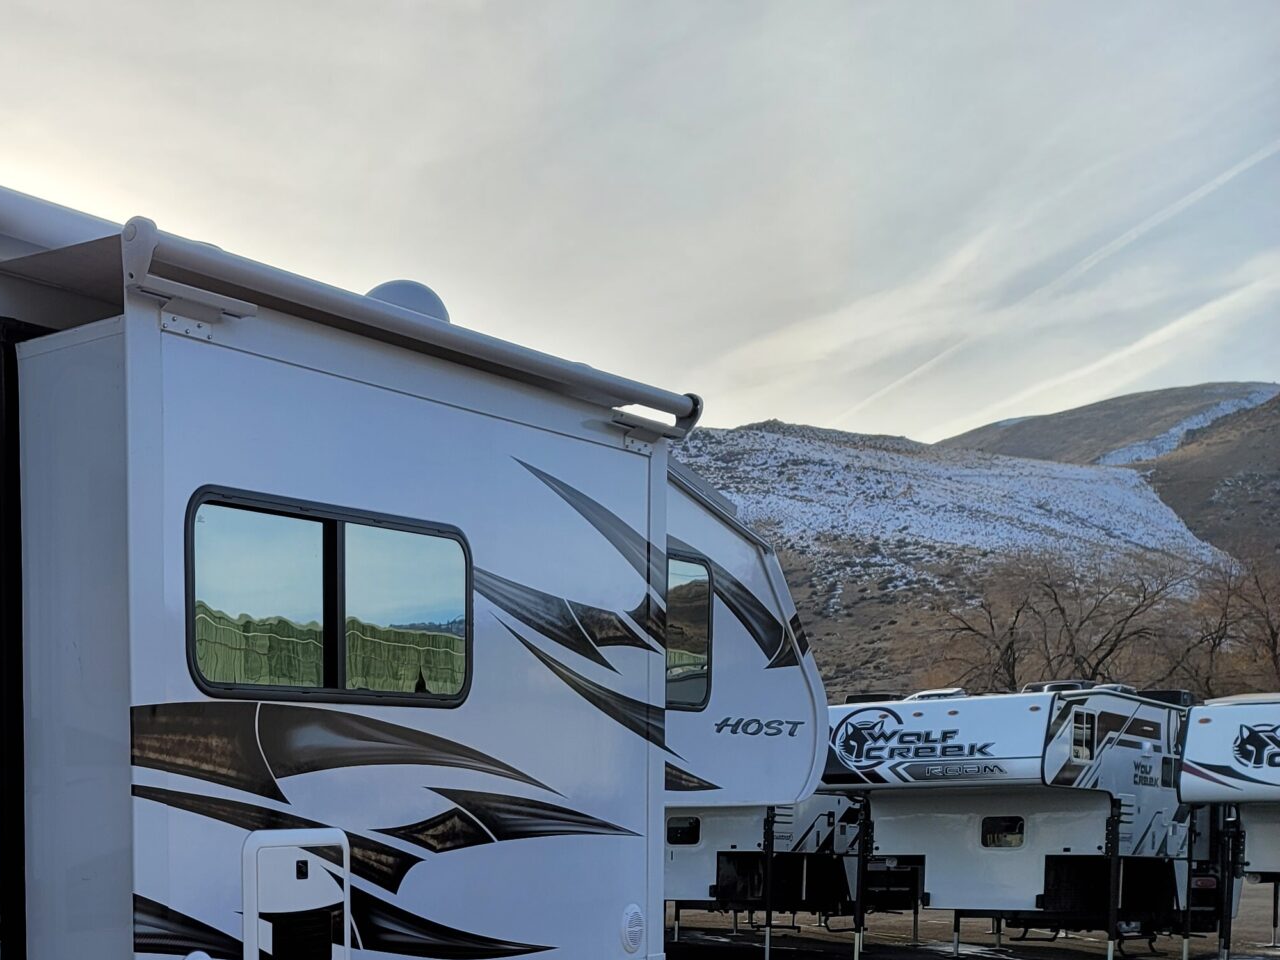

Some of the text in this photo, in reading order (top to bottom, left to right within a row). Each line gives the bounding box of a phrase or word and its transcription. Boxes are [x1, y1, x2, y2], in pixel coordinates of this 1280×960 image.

[714, 717, 805, 737] HOST
[866, 729, 959, 745] WOLF
[864, 743, 996, 760] CREEK
